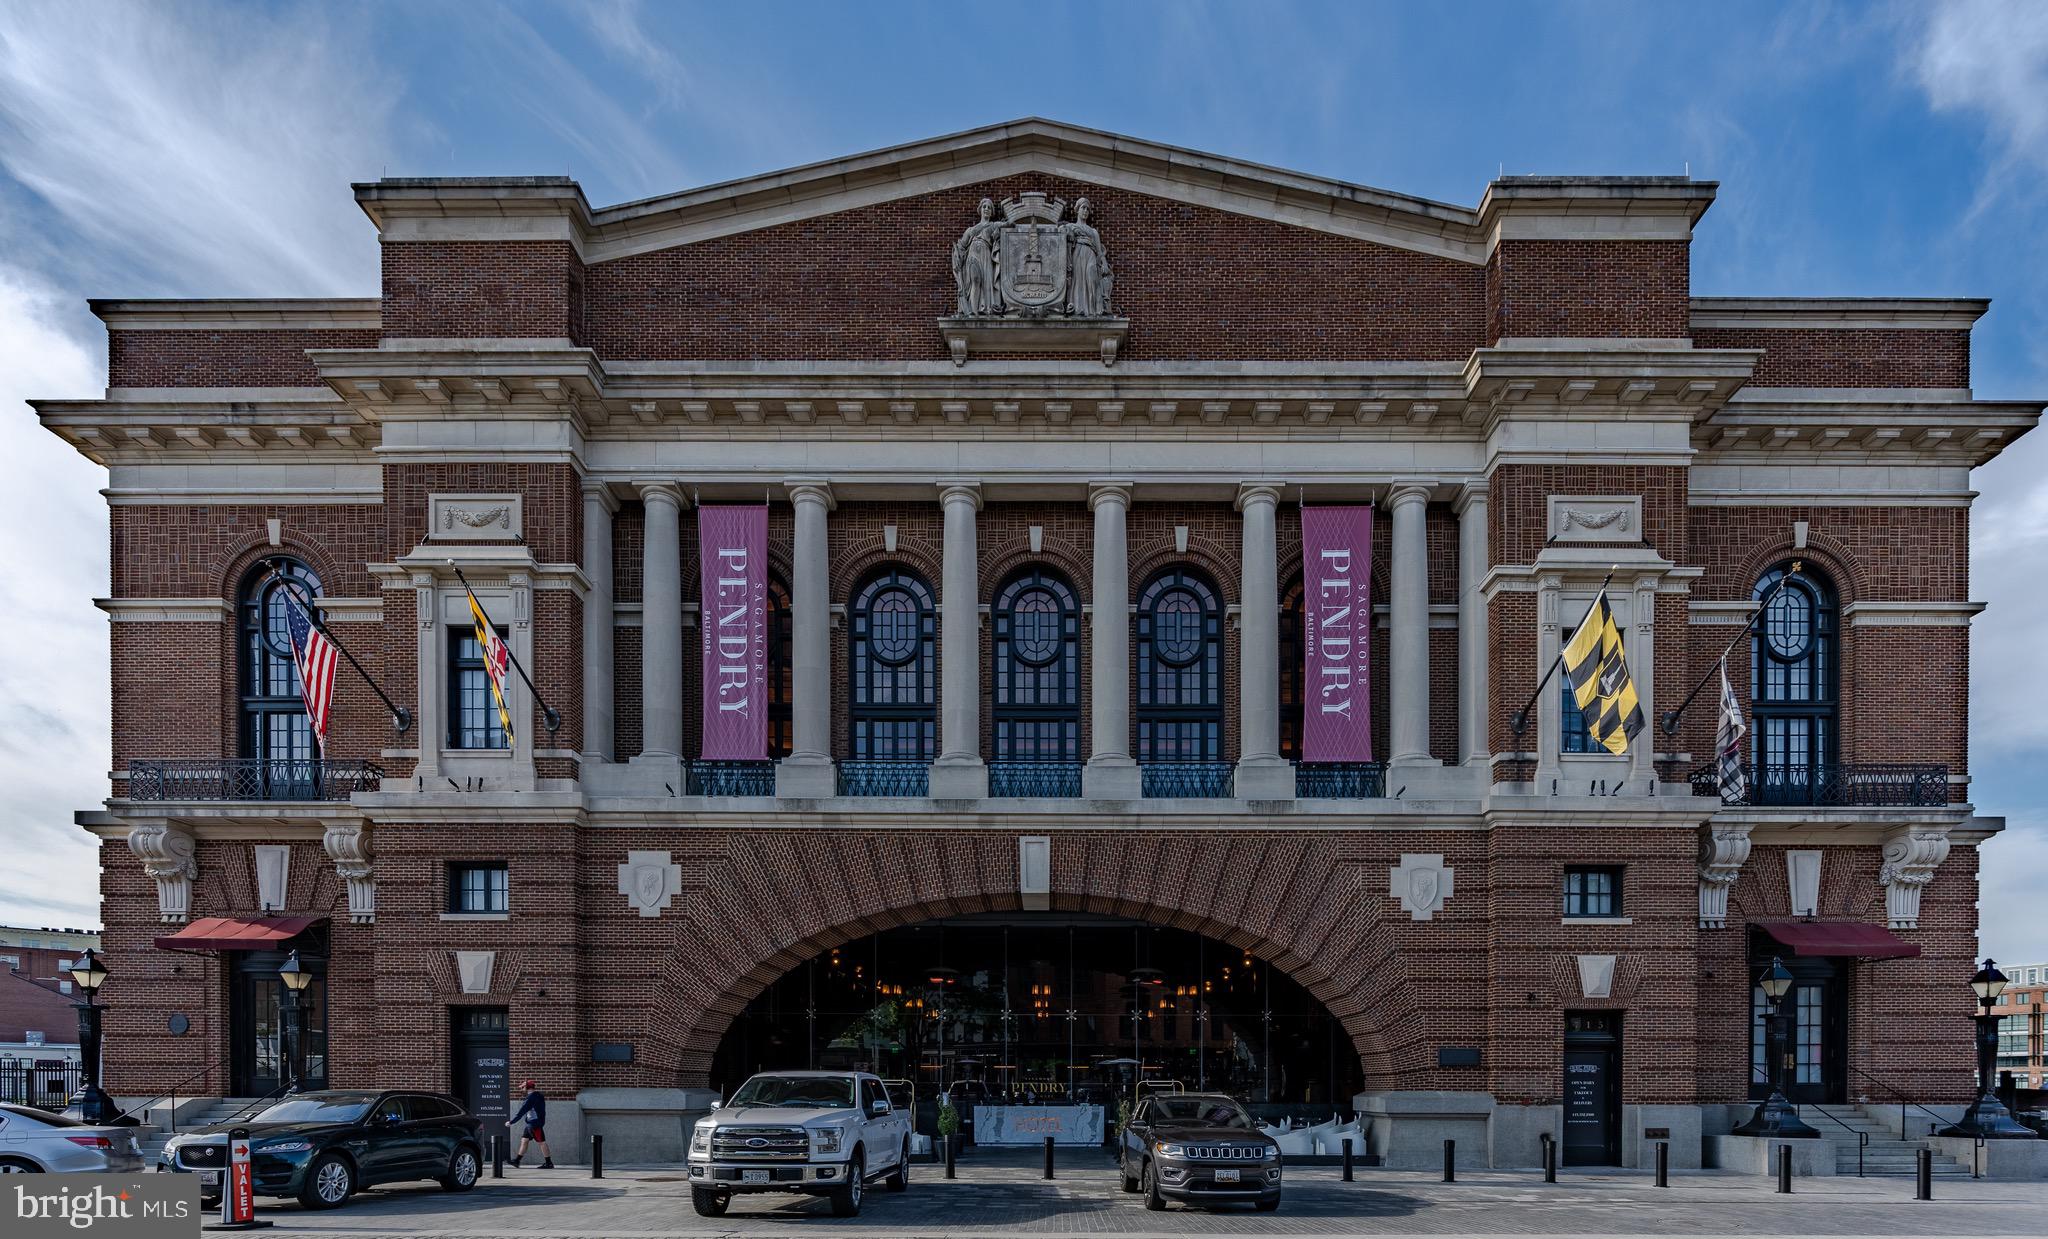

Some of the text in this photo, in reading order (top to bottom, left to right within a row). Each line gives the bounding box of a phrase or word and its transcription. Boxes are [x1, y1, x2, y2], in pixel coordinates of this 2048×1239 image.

[719, 547, 748, 719] PENDRY
[755, 583, 763, 683] SAGAMORE
[1321, 548, 1350, 720] PENDRY
[1358, 584, 1366, 685] SAGAMORE
[1011, 1082, 1066, 1093] PENDRY
[239, 1164, 248, 1217] VALET
